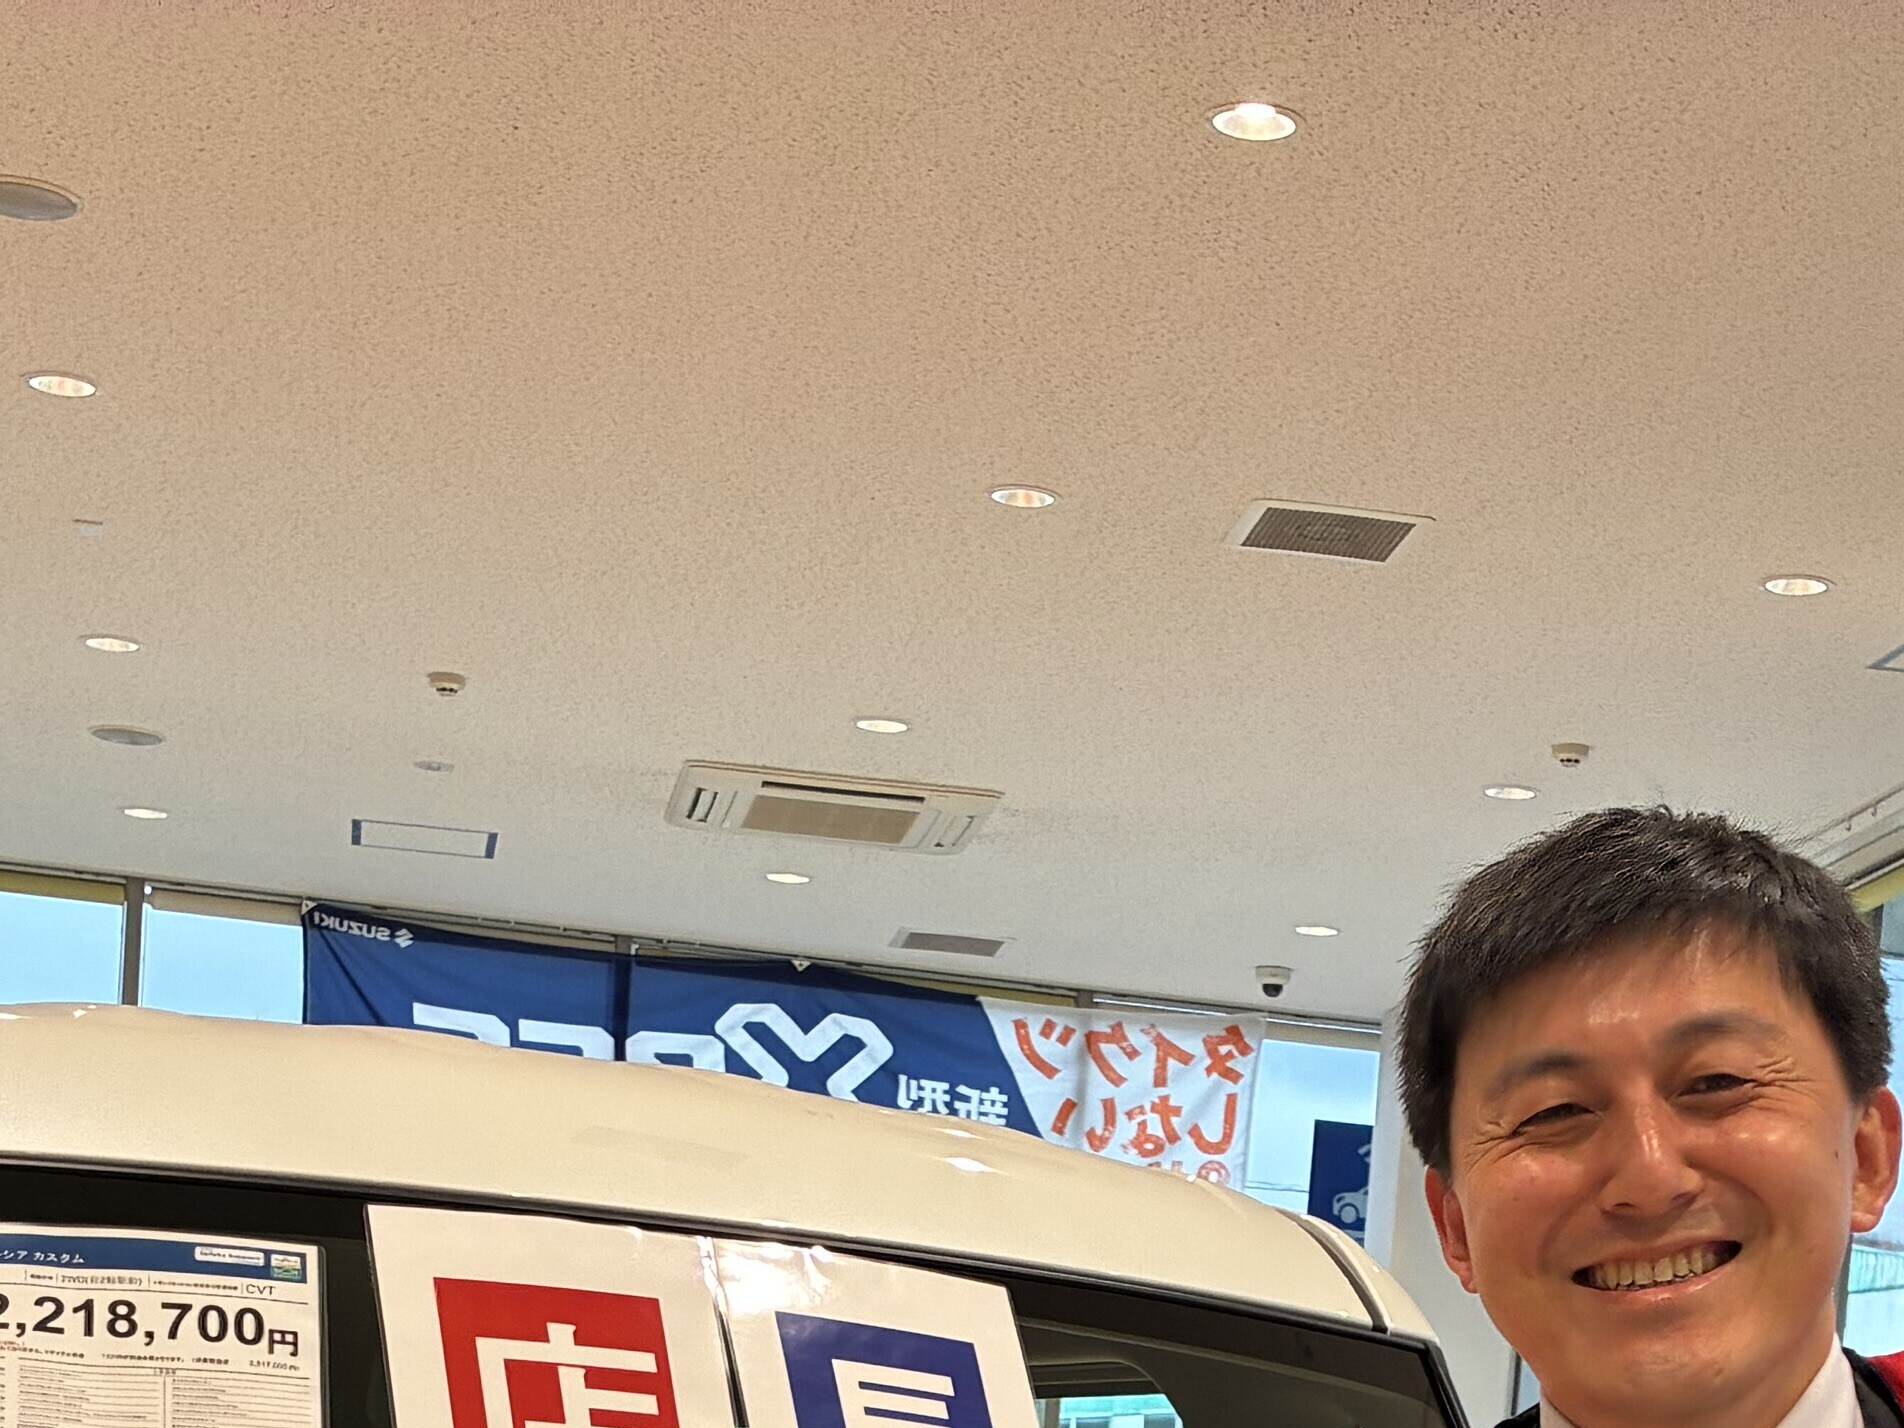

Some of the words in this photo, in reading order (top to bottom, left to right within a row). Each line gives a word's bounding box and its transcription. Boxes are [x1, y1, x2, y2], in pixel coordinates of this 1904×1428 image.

[33, 1251, 86, 1264] カスタム
[245, 1283, 277, 1296] CVT
